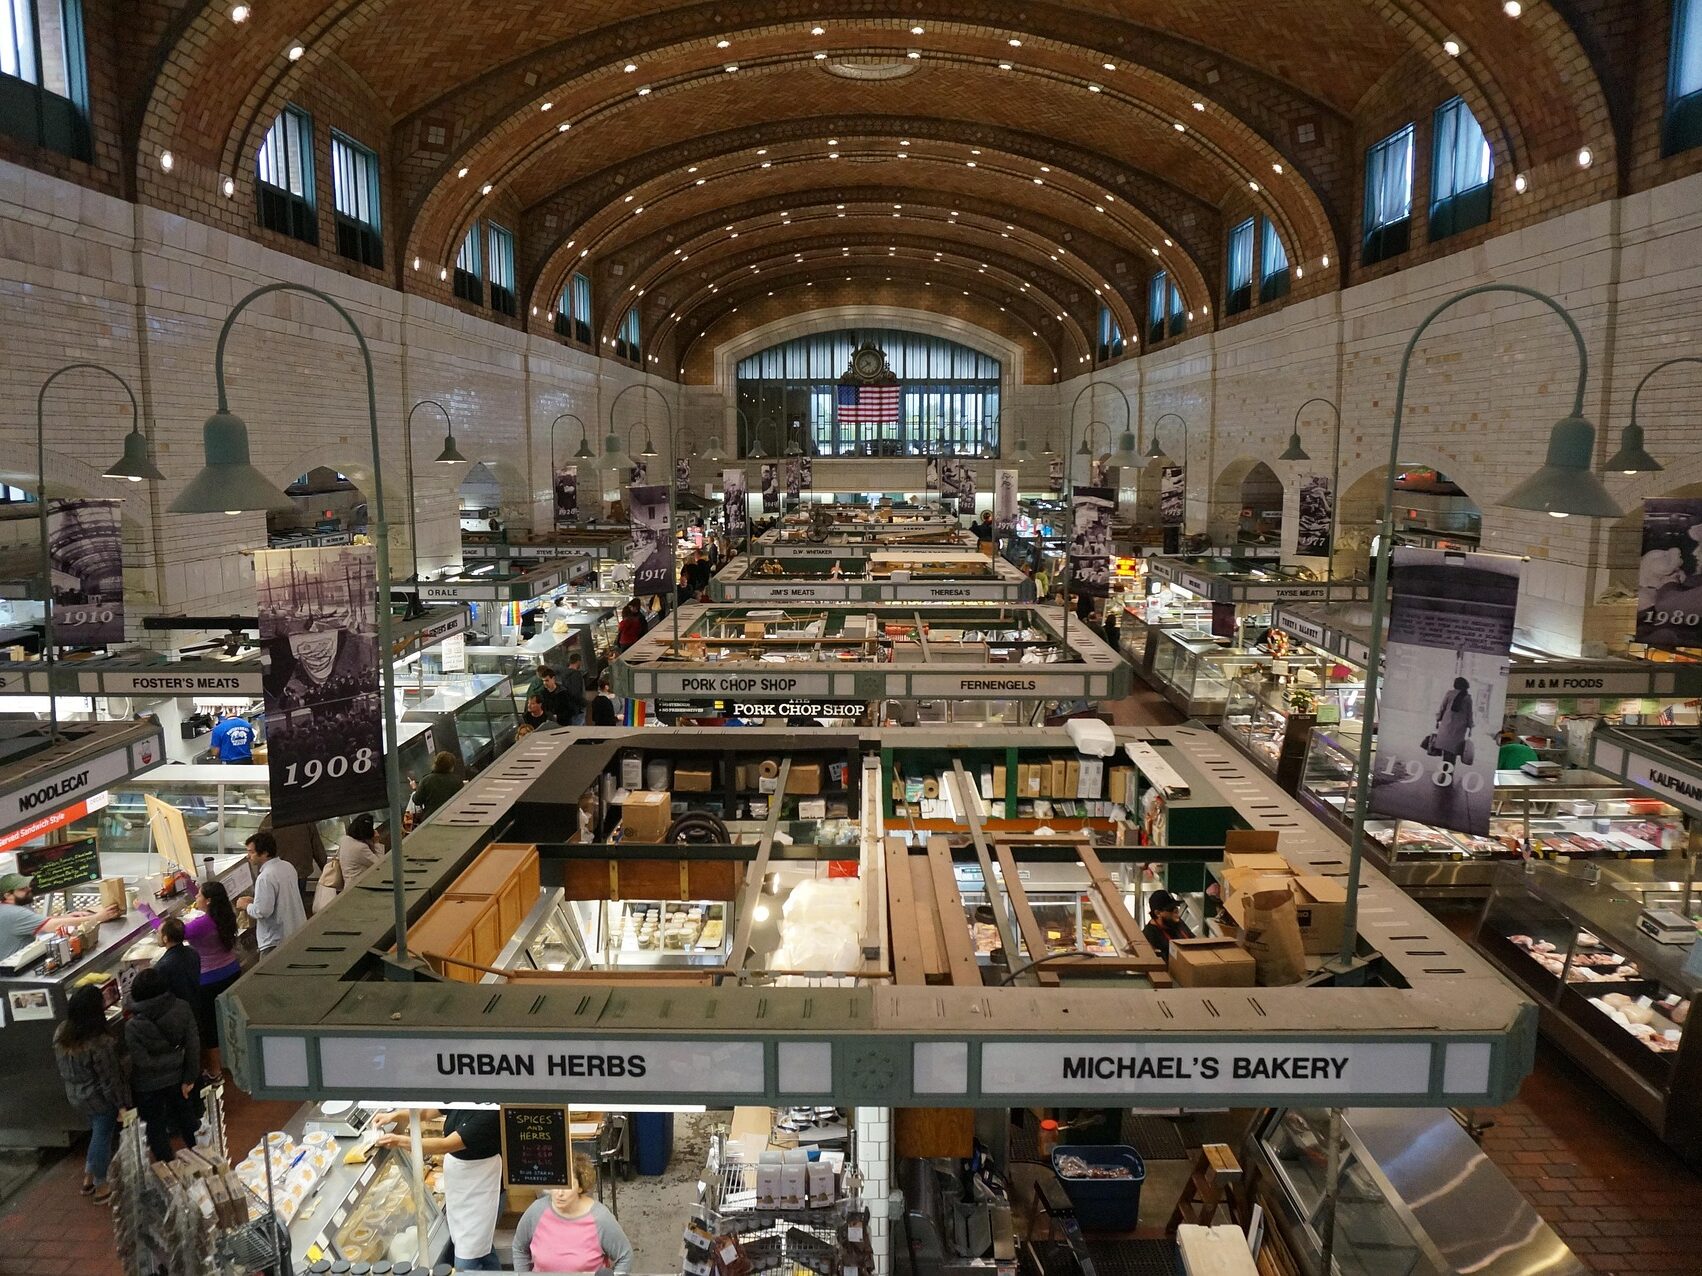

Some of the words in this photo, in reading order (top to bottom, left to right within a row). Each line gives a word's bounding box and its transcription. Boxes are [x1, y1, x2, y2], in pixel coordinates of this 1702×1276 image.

[1300, 537, 1326, 547] 1977
[640, 568, 668, 582] 1917
[427, 588, 458, 597] ORALE
[770, 589, 789, 597] JIM'S
[791, 589, 815, 597] MEATS
[930, 589, 971, 597] THERESA'S
[1276, 589, 1298, 597] TAYSE
[1299, 589, 1324, 597] MEATS
[62, 610, 113, 627] 1910
[1644, 609, 1700, 627] 1980
[132, 677, 194, 689] FOSTER'S
[197, 677, 240, 689] MEATS
[682, 678, 717, 691] PORK
[720, 678, 757, 691] CHOP
[760, 678, 797, 691] SHOP
[960, 680, 1036, 690] FERNENGELS
[1525, 679, 1535, 688] M
[1538, 679, 1546, 688] &
[1549, 679, 1559, 688] M
[1563, 679, 1604, 688] FOODS
[733, 703, 776, 716] PORK
[778, 703, 821, 716] CHOP
[823, 703, 865, 716] SHOP
[283, 747, 373, 789] 1908
[1381, 754, 1485, 794] 1980
[18, 770, 90, 813] NOODLECAT
[20, 820, 49, 838] Sandwich
[50, 812, 65, 826] Style
[437, 1053, 534, 1077] URBAN
[547, 1053, 646, 1077] HERBS
[1063, 1057, 1220, 1080] MICHAEL'S
[1232, 1057, 1349, 1080] BAKERY
[516, 1114, 552, 1124] SPICES
[520, 1132, 551, 1140] HERBS
